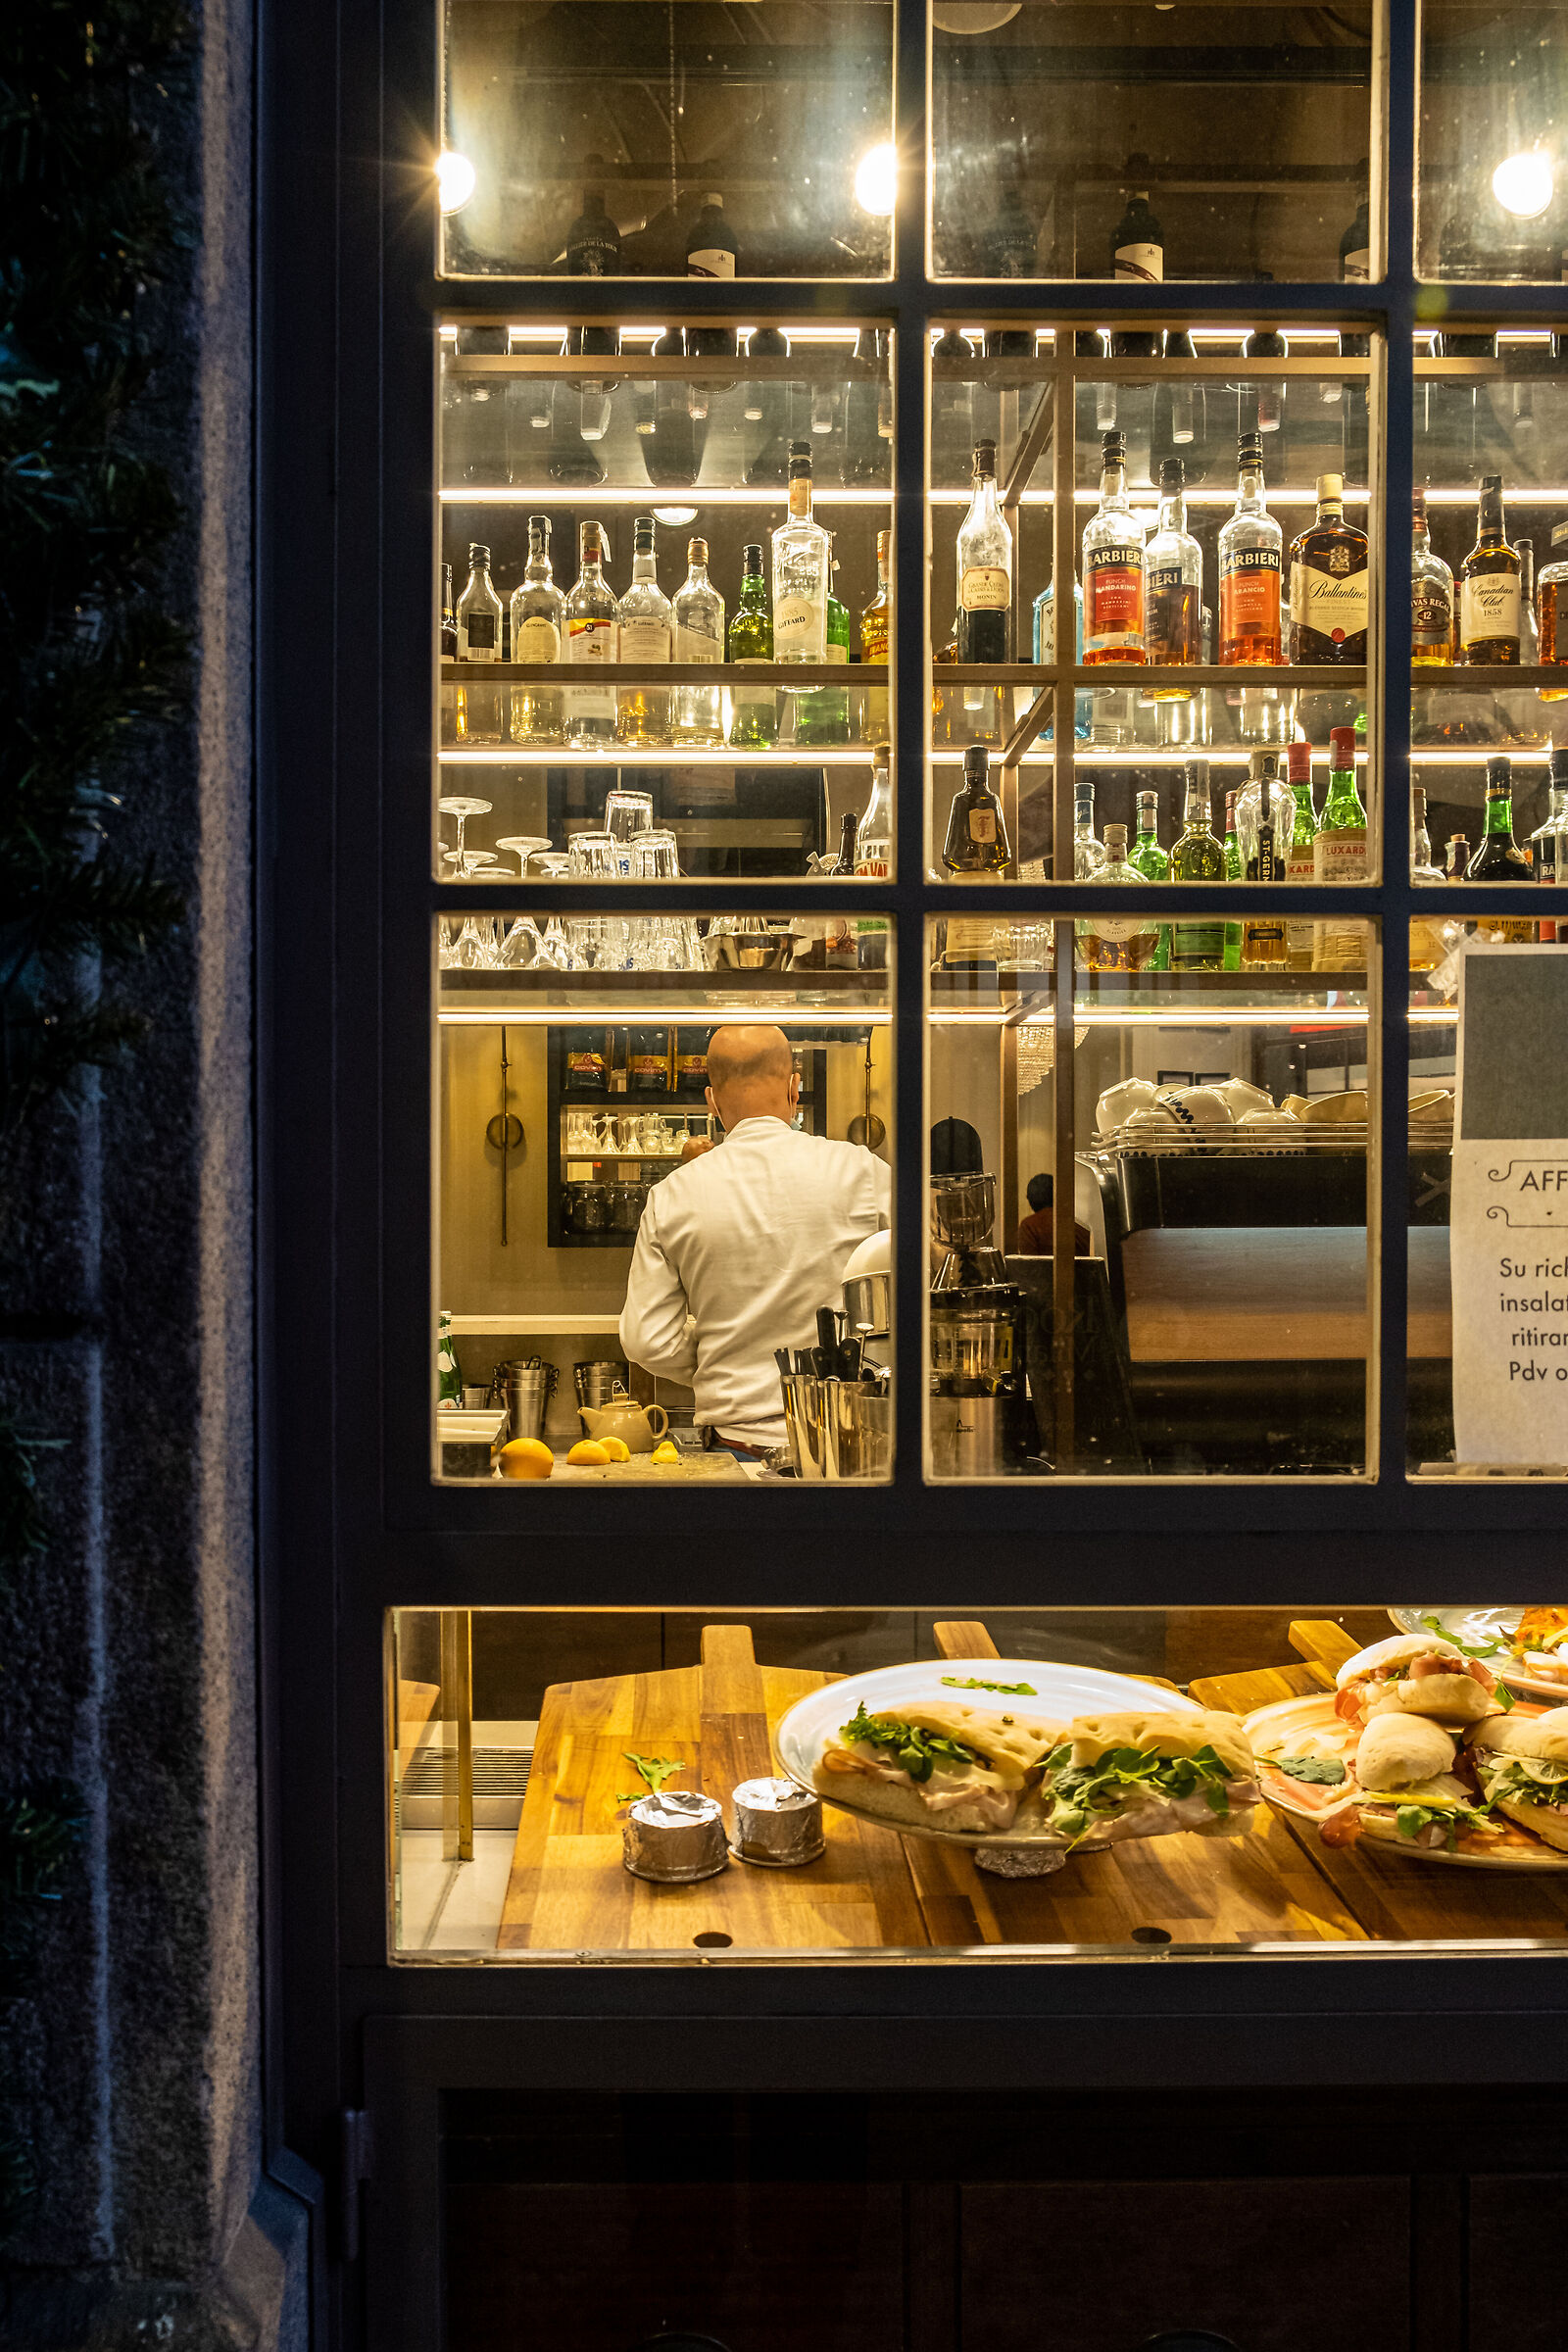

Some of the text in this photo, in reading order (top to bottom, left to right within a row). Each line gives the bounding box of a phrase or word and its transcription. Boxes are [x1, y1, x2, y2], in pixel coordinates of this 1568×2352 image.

[1472, 584, 1515, 597] Canadian
[1481, 595, 1504, 608] Club
[1483, 608, 1503, 617] 1858
[1326, 845, 1367, 857] LUXARD
[1519, 1169, 1568, 1192] AFF
[1499, 1256, 1526, 1278] Su
[1509, 1358, 1547, 1381] Pdv
